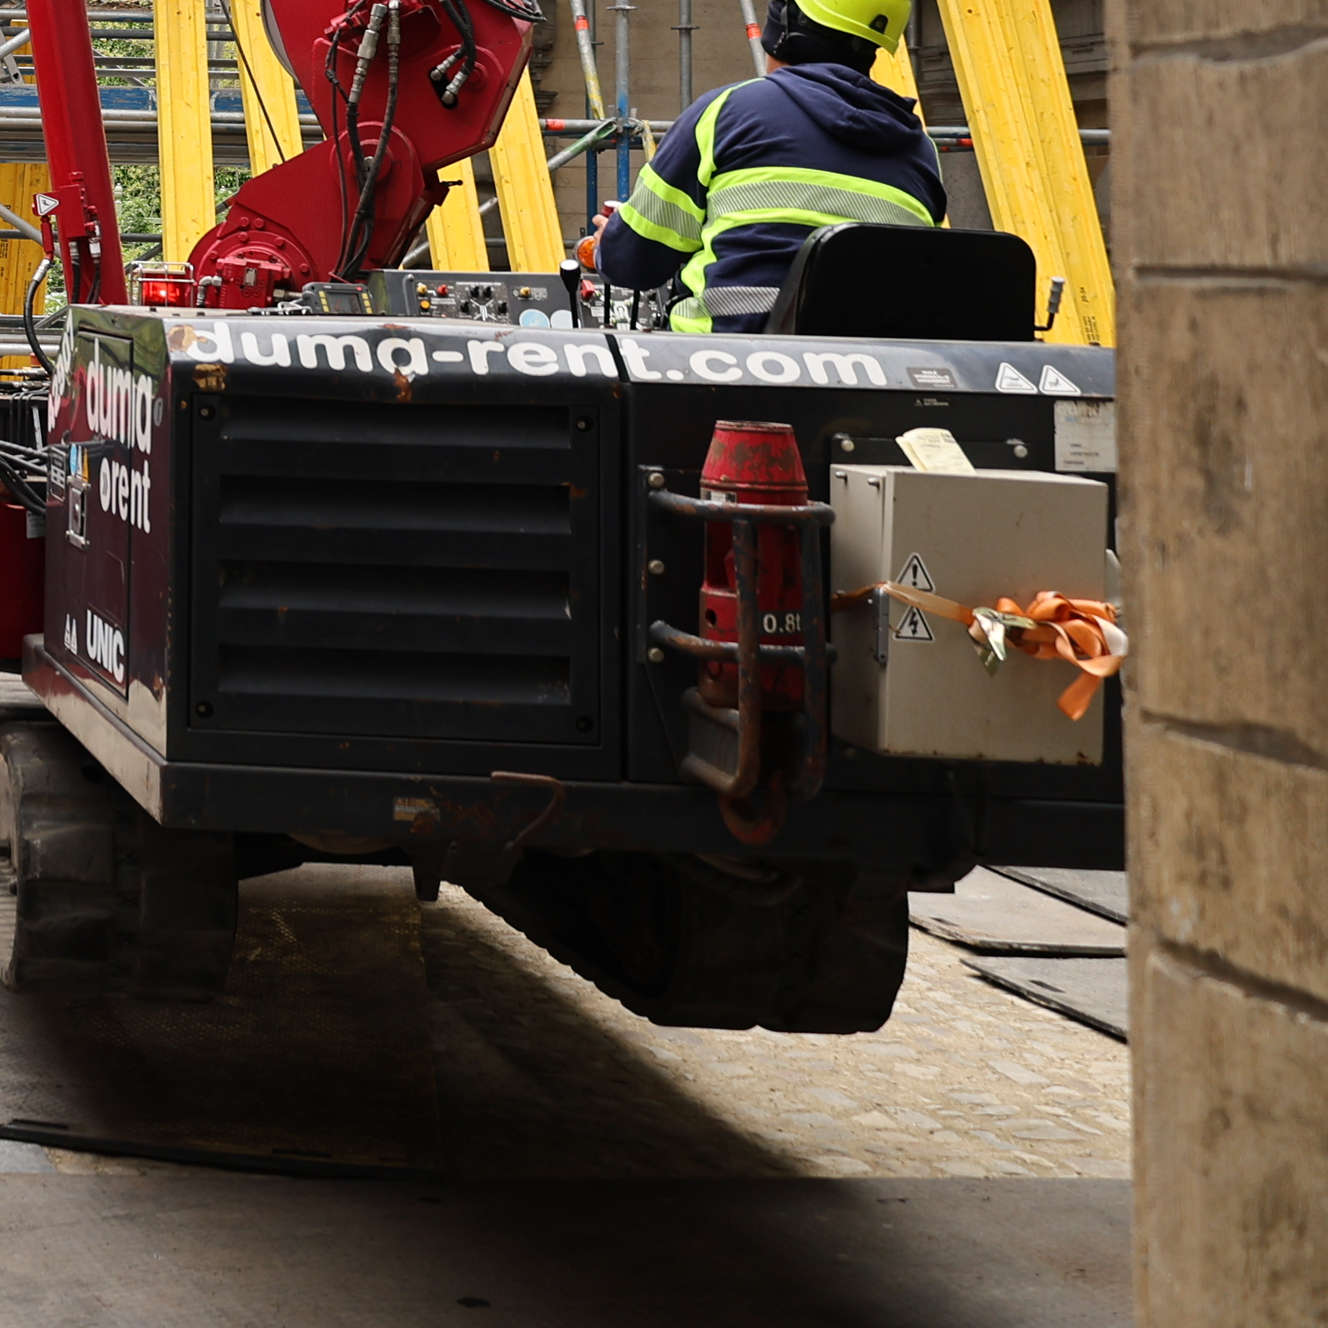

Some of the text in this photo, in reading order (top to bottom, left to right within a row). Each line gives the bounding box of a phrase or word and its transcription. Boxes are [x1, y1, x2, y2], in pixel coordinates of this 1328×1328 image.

[187, 320, 887, 386] duma-rent.com
[87, 336, 152, 455] duma
[111, 459, 150, 534] rent
[86, 609, 125, 683] UNIC
